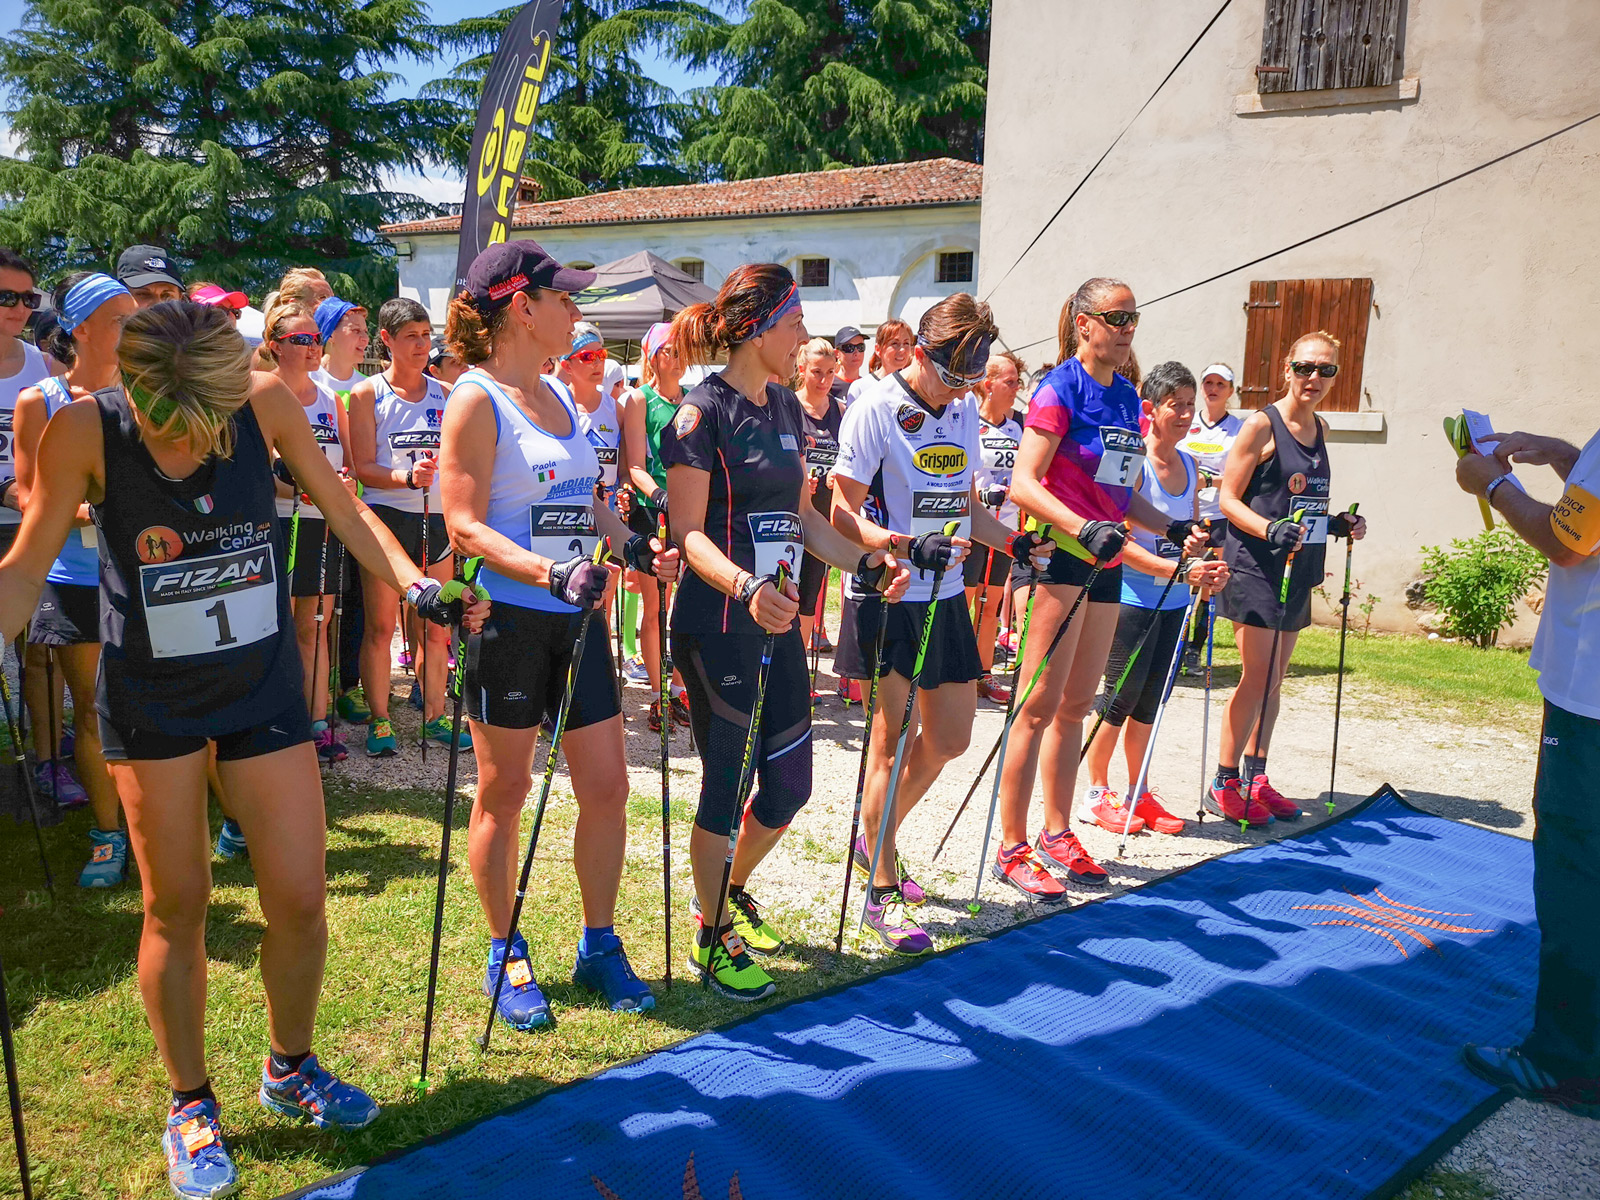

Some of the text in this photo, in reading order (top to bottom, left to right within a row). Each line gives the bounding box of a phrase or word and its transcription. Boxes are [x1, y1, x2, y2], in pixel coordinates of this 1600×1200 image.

[1105, 433, 1144, 447] FIZAN
[532, 460, 557, 472] Paola
[919, 451, 965, 471] Grisport
[994, 451, 1014, 468] 28
[1119, 455, 1133, 484] 5
[547, 489, 573, 499] Sport
[574, 487, 584, 495] &
[917, 497, 968, 509] FIZAN
[1294, 501, 1328, 511] FIZAN
[538, 511, 595, 525] FIZAN
[757, 519, 800, 534] FIZAN
[1306, 518, 1317, 541] 7
[1555, 518, 1582, 541] Walking
[183, 522, 254, 546] Walking
[152, 556, 264, 592] FIZAN
[160, 589, 174, 597] MADE
[180, 586, 193, 595] ITALY
[192, 585, 206, 594] SINCE
[205, 599, 238, 647] 1
[918, 610, 933, 656] FIZAN
[454, 640, 466, 698] FIZAN
[2, 672, 11, 701] SPEED
[871, 667, 881, 699] LEKI
[752, 701, 765, 733] LEKI
[742, 736, 754, 769] LEKI
[544, 746, 558, 785] LEKI
